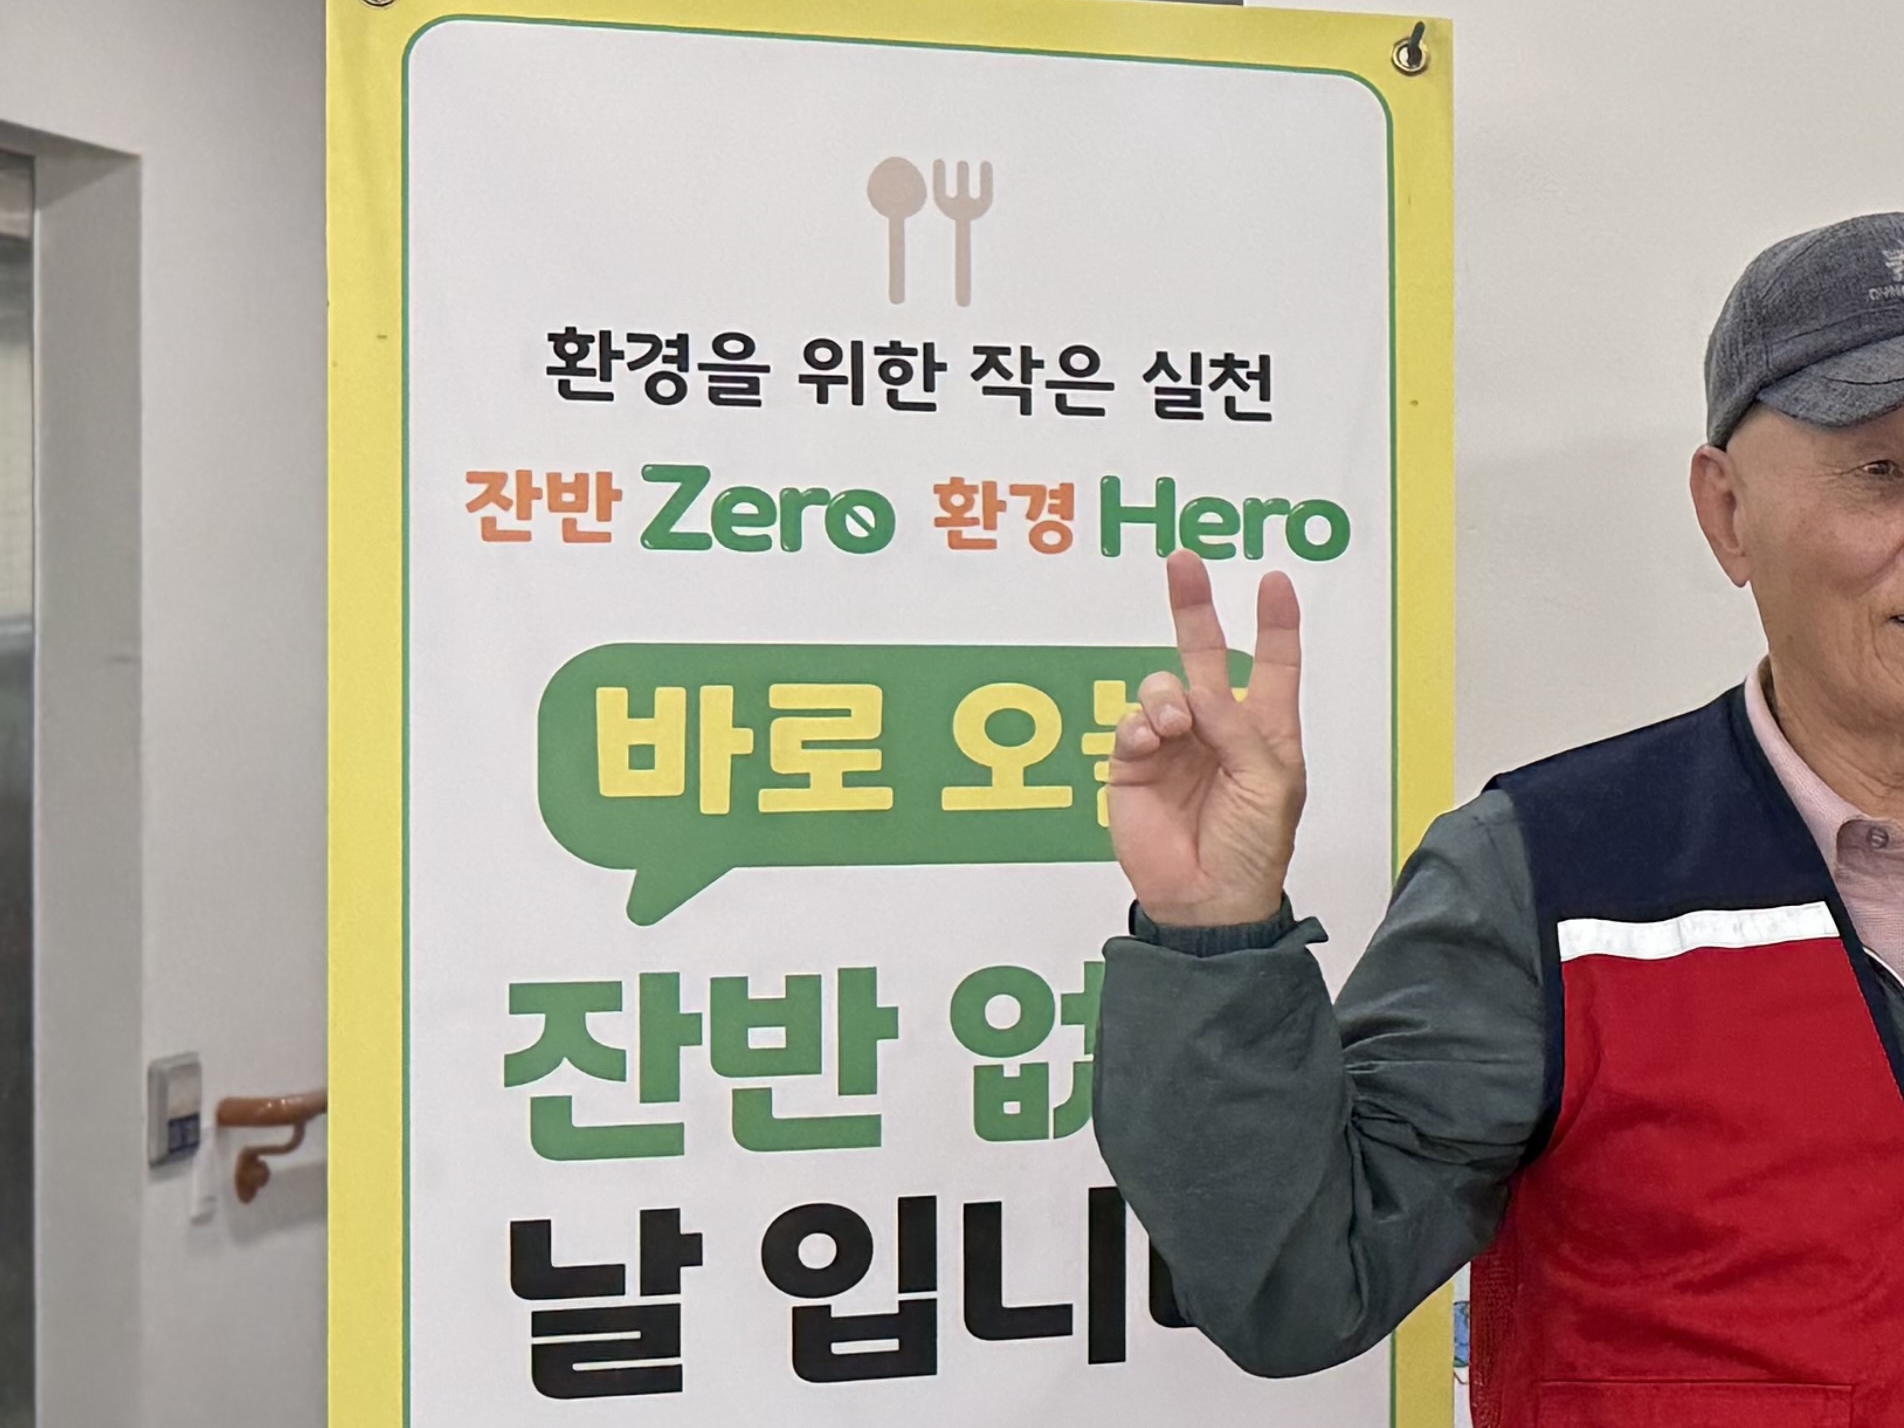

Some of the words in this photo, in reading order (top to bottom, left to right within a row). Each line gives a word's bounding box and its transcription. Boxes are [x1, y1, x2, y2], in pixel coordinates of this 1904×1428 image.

[545, 326, 770, 410] 환경을
[798, 338, 947, 412] 위한
[970, 343, 1116, 419] 작은
[1142, 349, 1275, 423] 실천
[464, 468, 624, 544] 잔반
[639, 462, 897, 553] Zero
[932, 476, 1077, 554] 환경
[1098, 474, 1352, 563] Hero
[596, 680, 893, 814] 바로
[503, 968, 900, 1161] 잔반
[508, 1208, 703, 1400] 날
